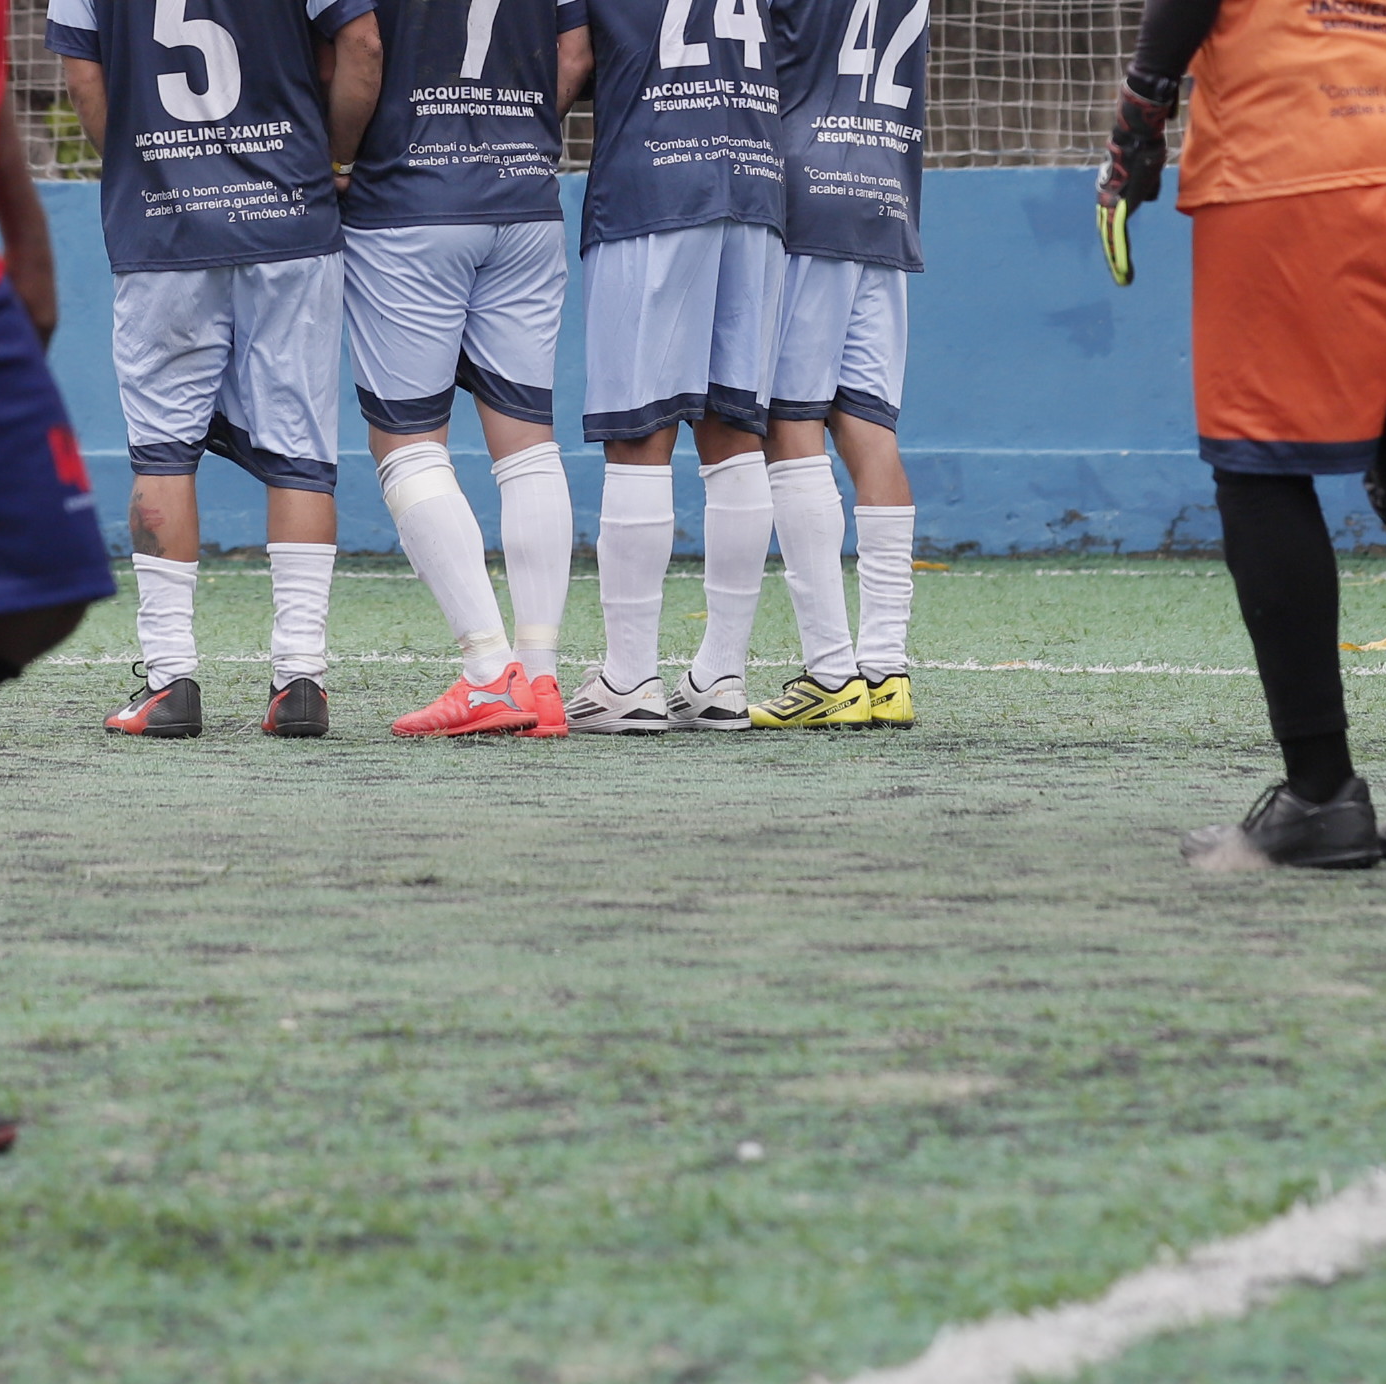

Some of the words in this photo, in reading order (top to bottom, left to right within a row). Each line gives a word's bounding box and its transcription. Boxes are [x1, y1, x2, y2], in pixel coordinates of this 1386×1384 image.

[409, 86, 492, 102] JACQUEINE
[497, 88, 544, 104] XAVIER
[740, 81, 780, 102] XAVIER
[416, 103, 475, 117] SEGURANÇ
[488, 105, 534, 117] TRABALHO
[653, 96, 721, 112] SEGURANÇA
[731, 97, 778, 114] TRABALHO
[135, 126, 227, 147] JACQUELINE
[230, 121, 293, 140] XAVIER
[817, 131, 865, 147] SEGURÇA
[867, 135, 878, 146] DO
[142, 144, 203, 162] SEGURANÇA
[206, 144, 222, 155] DO
[225, 139, 284, 154] TRABALHO
[409, 141, 456, 154] Combati
[459, 143, 466, 151] o
[492, 142, 538, 151] combate,
[701, 139, 709, 147] o
[711, 135, 728, 146] bo
[728, 139, 773, 152] combate,
[408, 155, 448, 167] acabei
[452, 155, 459, 163] a
[652, 151, 692, 167] acabei
[694, 152, 702, 161] a
[498, 168, 506, 179] 2
[508, 165, 549, 177] Timóteo
[733, 164, 740, 175] 2
[854, 174, 859, 182] o
[861, 173, 877, 185] bom
[182, 189, 190, 198] o
[193, 186, 219, 197] bom
[222, 180, 277, 194] combate,
[809, 184, 846, 195] acabei
[848, 187, 854, 196] a
[145, 205, 173, 217] acabei
[175, 205, 182, 213] a
[281, 193, 289, 202] a
[878, 205, 884, 215] 2
[228, 212, 236, 223] 2
[239, 208, 287, 222] Timóteo
[825, 700, 852, 715] umbro
[871, 696, 887, 706] mbro
